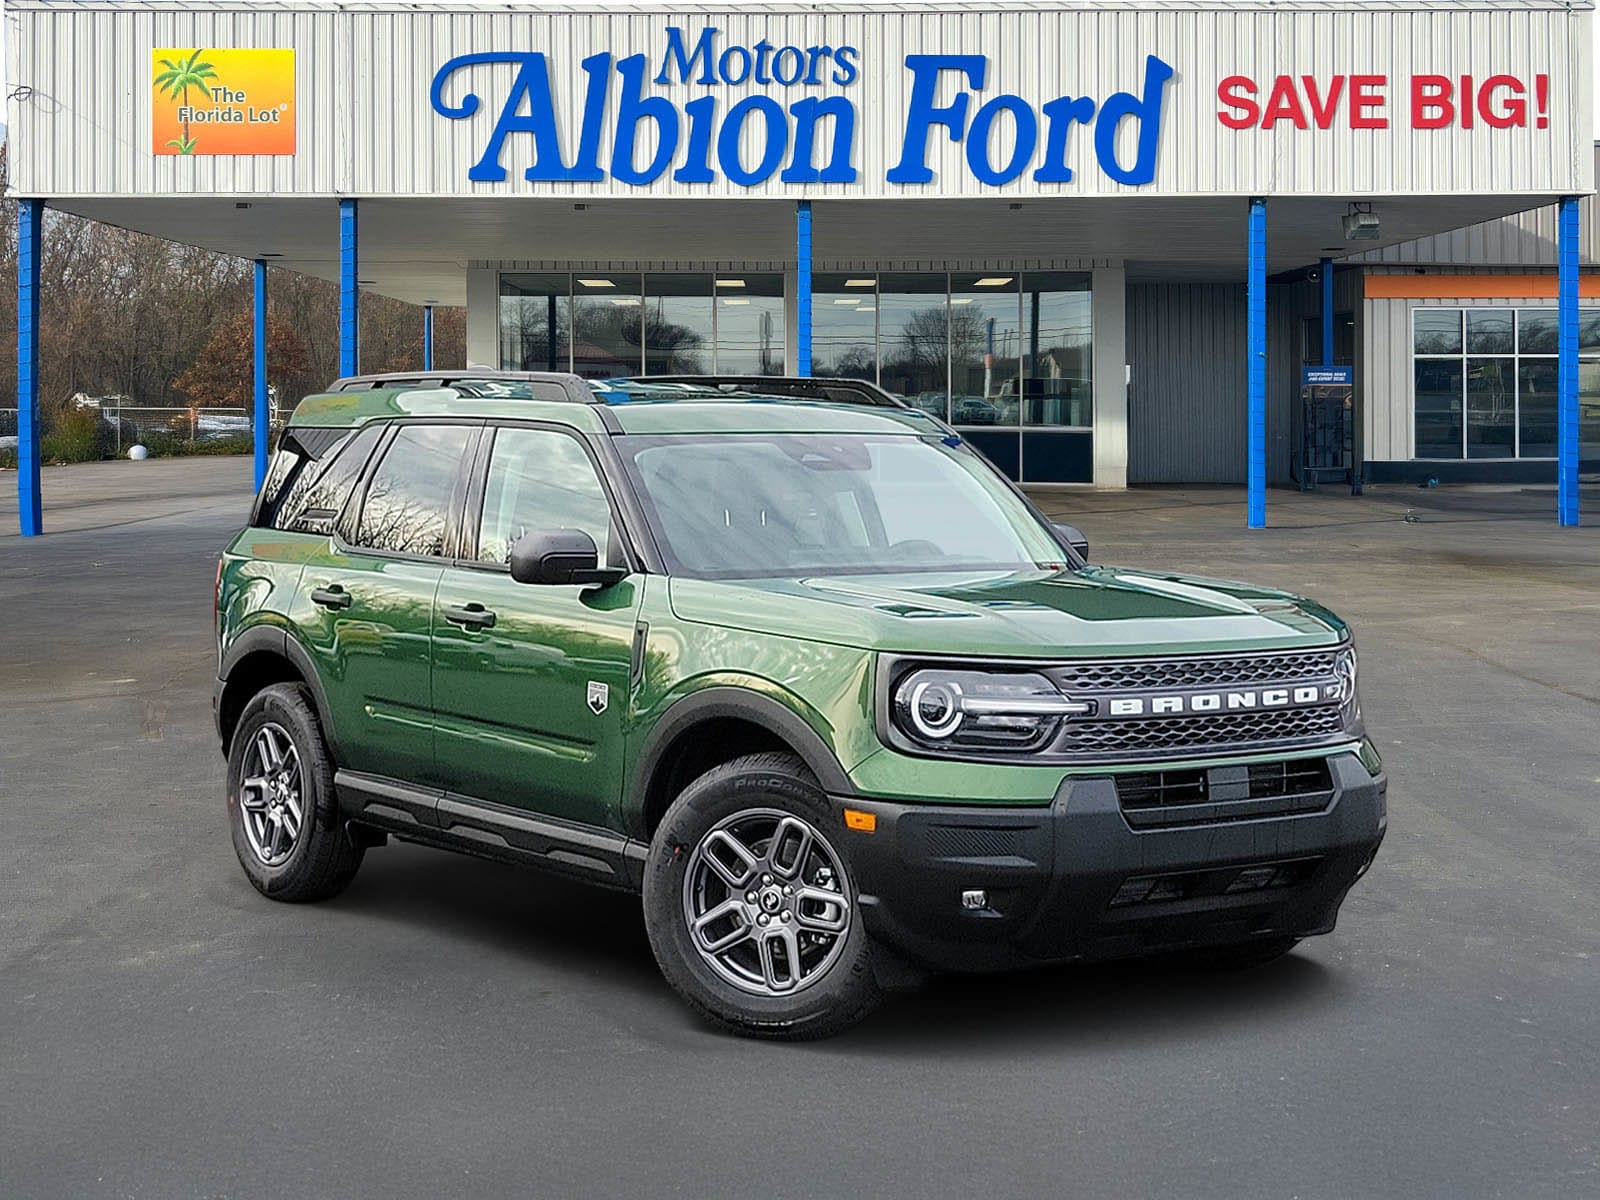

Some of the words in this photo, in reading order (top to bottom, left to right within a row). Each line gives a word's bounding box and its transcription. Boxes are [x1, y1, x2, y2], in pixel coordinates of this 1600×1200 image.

[655, 28, 856, 85] Motors
[178, 106, 243, 122] Florida
[248, 107, 279, 122] Lot
[211, 86, 246, 103] The
[1218, 75, 1388, 129] SAVE
[1411, 75, 1548, 129] BIG!
[431, 52, 857, 186] Albion
[887, 54, 1173, 186] Ford
[1110, 686, 1318, 715] BRONCO
